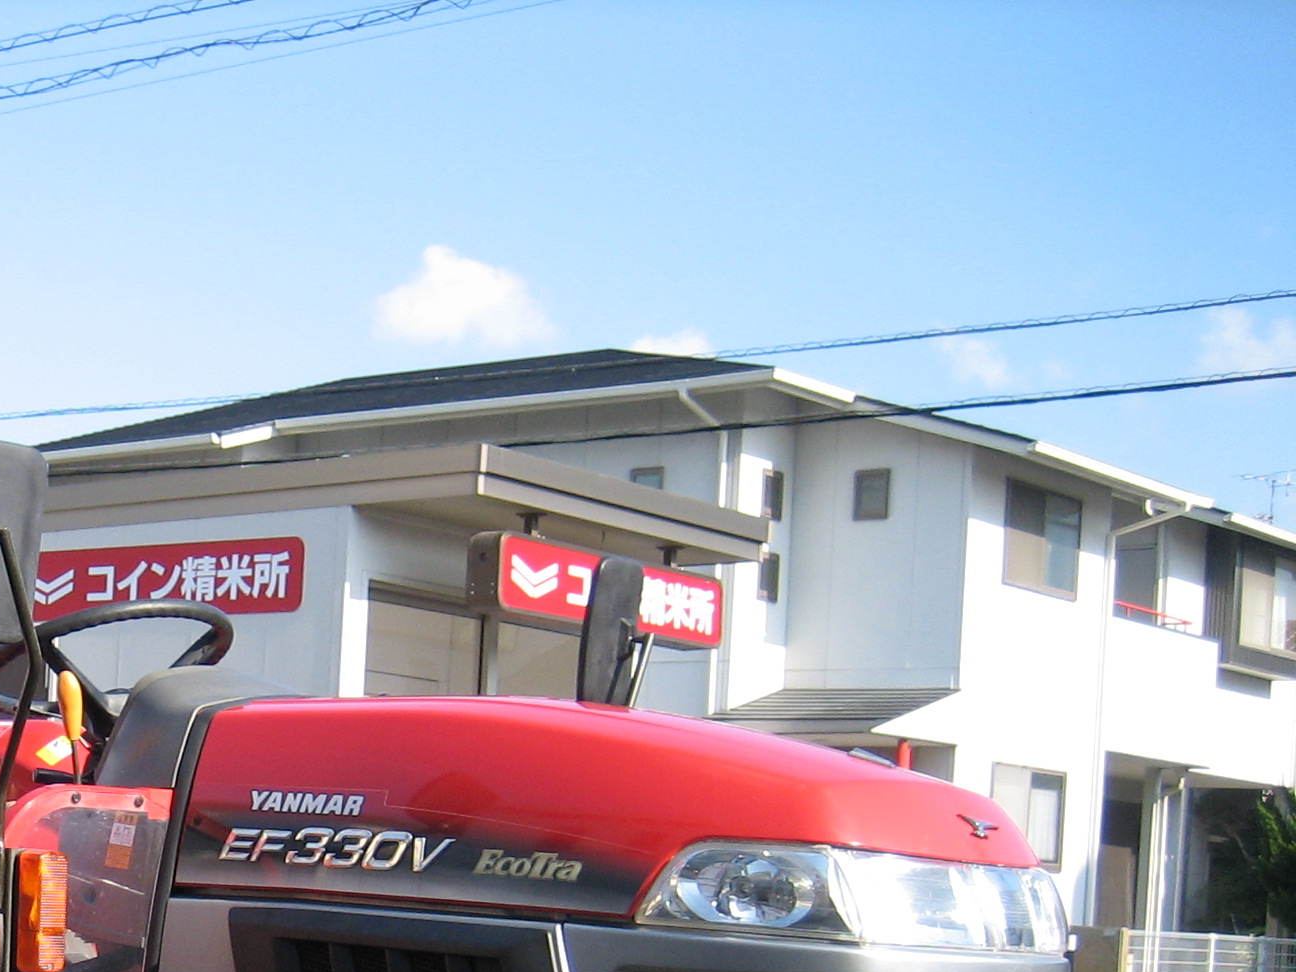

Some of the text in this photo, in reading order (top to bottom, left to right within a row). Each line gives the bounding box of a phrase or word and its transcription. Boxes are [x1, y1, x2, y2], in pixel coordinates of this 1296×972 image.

[85, 550, 291, 602] コイン精米所
[565, 564, 716, 636] コ精米所
[250, 789, 366, 817] YANMAR
[218, 827, 457, 872] EF330V
[473, 848, 584, 882] EcoTra
